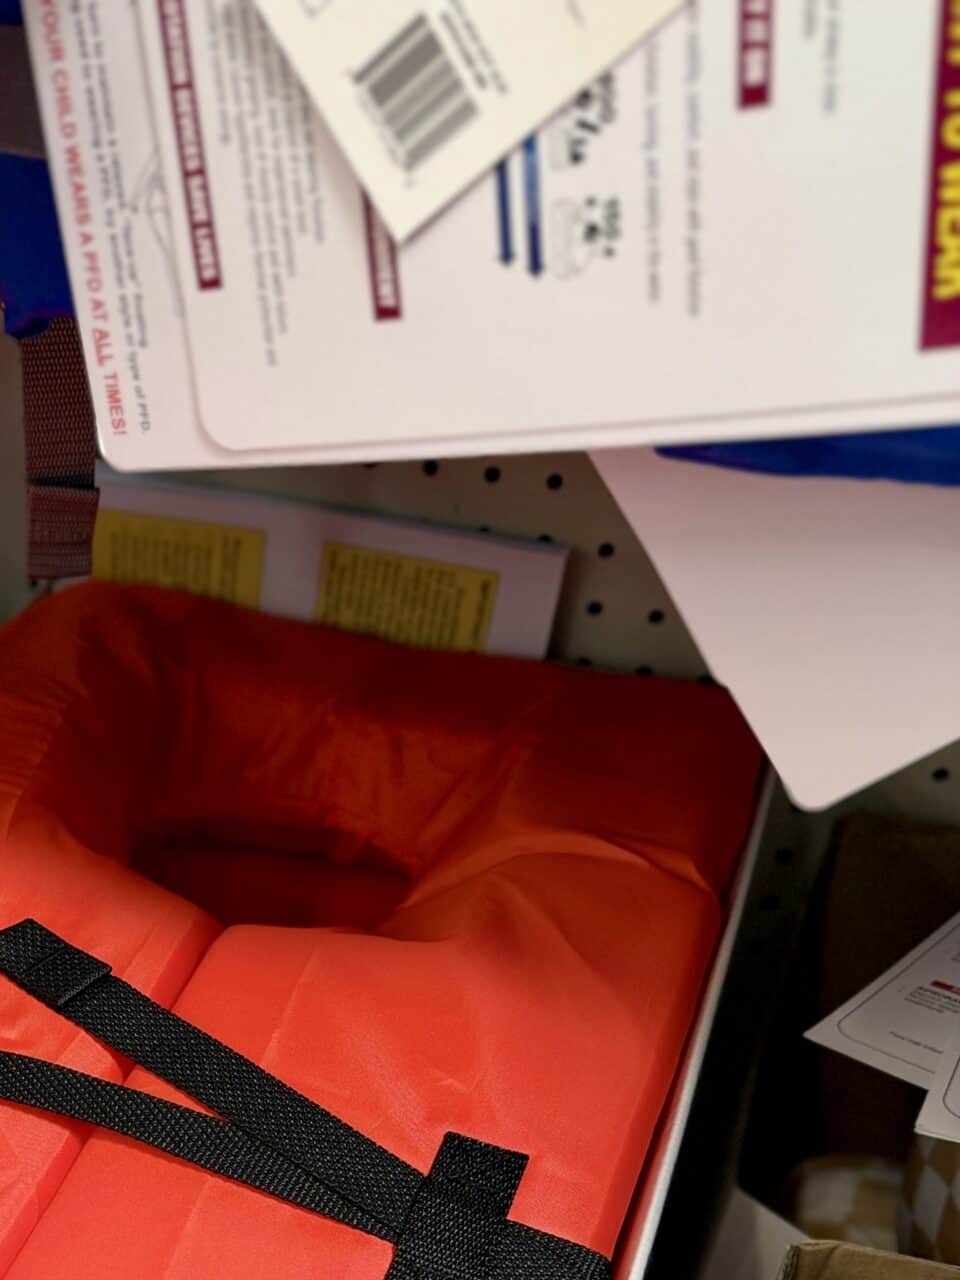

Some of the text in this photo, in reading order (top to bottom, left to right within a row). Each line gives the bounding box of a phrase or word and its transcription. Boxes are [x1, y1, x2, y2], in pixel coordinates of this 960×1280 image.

[52, 68, 77, 139] CHILD
[65, 145, 92, 225] WEARS
[80, 232, 94, 246] A
[84, 252, 103, 292] PFD
[91, 298, 109, 321] AT
[92, 327, 114, 367] ALL
[104, 372, 128, 436] TIMES!
